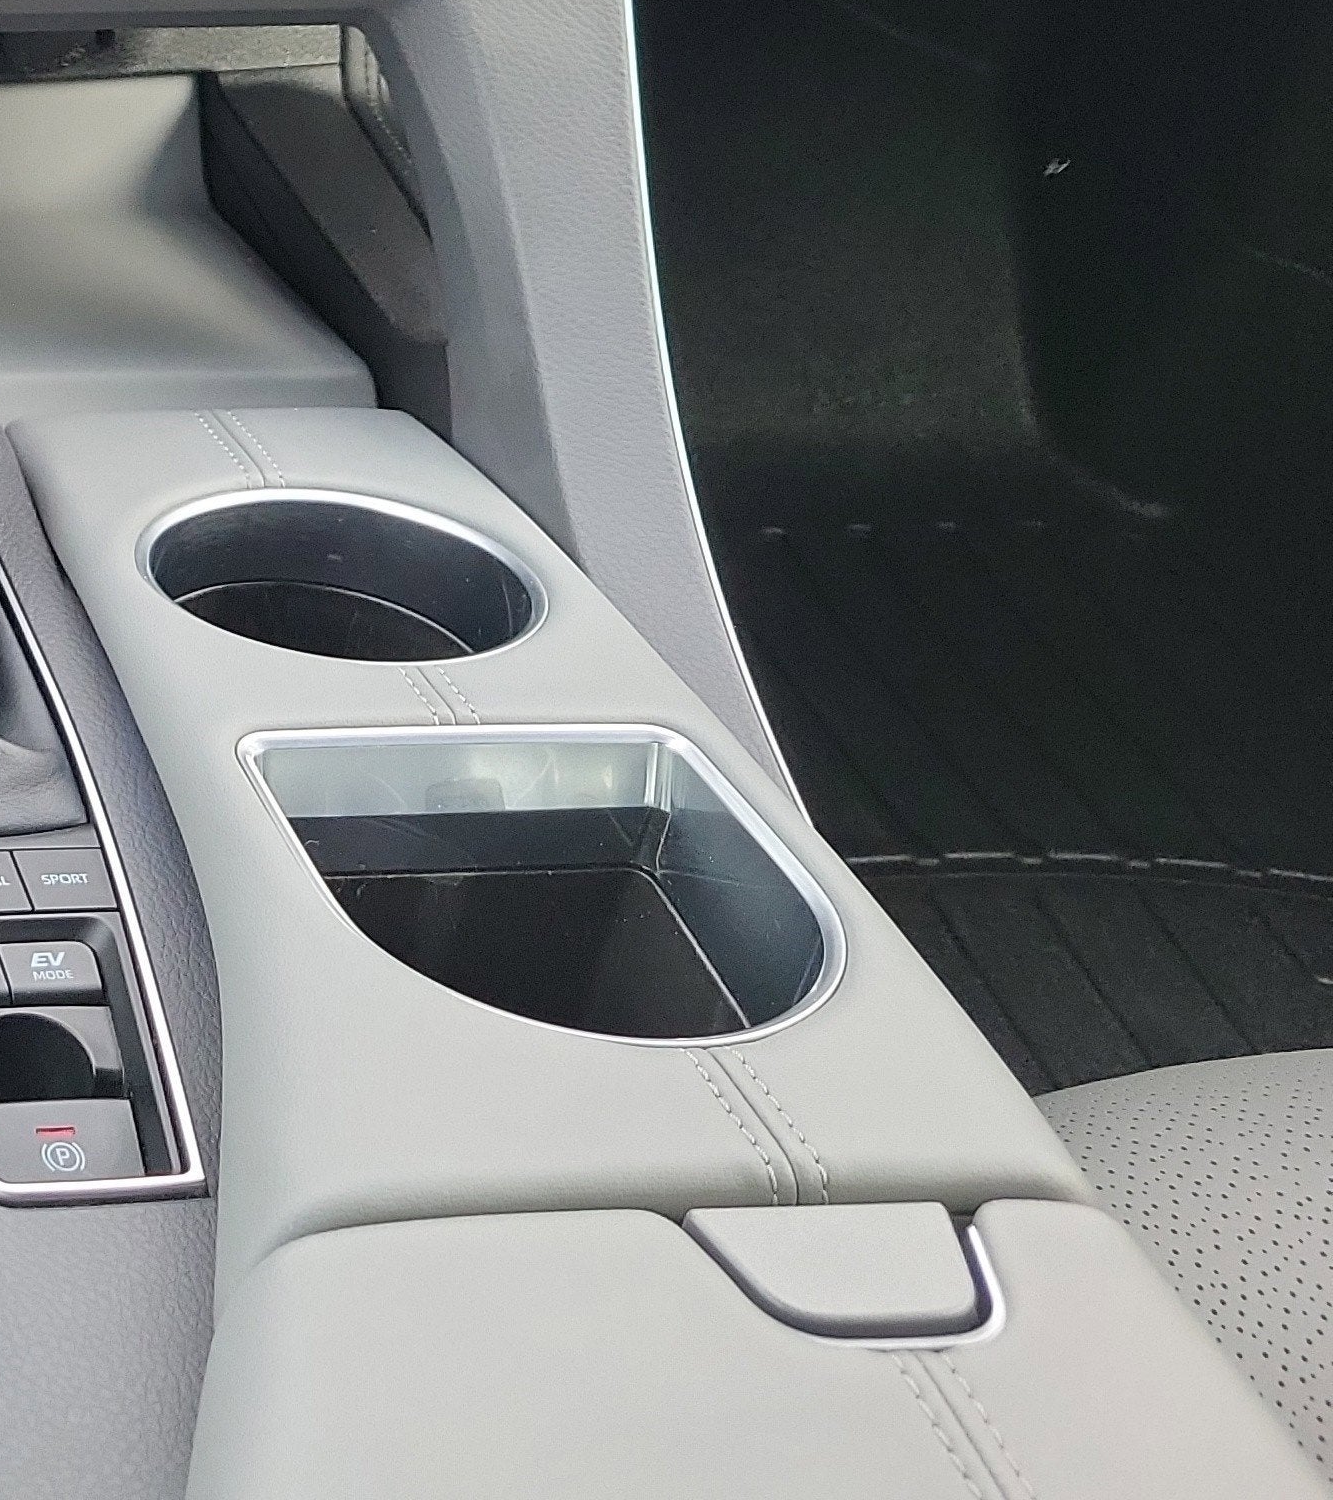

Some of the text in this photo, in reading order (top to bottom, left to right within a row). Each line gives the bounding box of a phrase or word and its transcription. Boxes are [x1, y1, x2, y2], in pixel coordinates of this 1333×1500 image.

[41, 871, 89, 885] SPORT
[30, 951, 65, 968] EV
[33, 969, 74, 981] MODE
